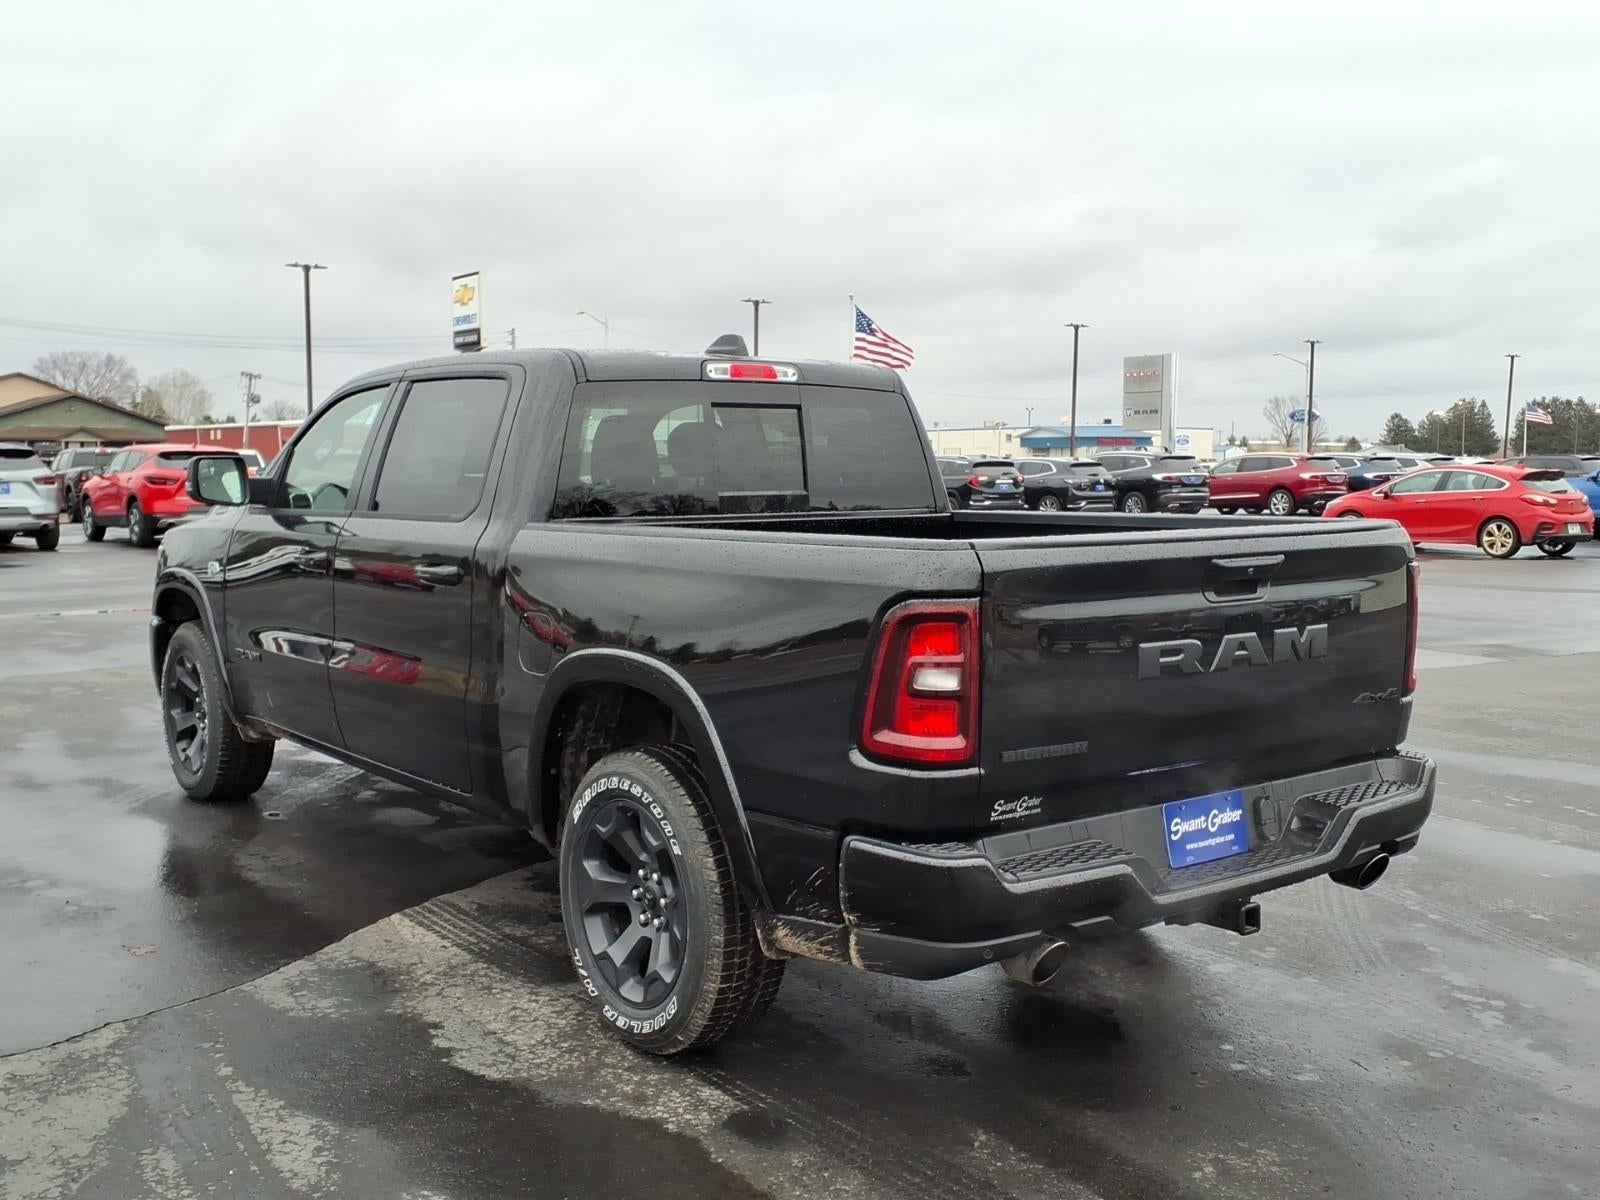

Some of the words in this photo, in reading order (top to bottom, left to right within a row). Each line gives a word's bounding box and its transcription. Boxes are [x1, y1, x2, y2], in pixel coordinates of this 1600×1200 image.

[1138, 623, 1328, 680] RAM
[572, 776, 682, 856] BRIDGESTONE
[1170, 815, 1207, 841] Swant
[1207, 808, 1242, 833] Graber
[602, 996, 678, 1034] DUELER
